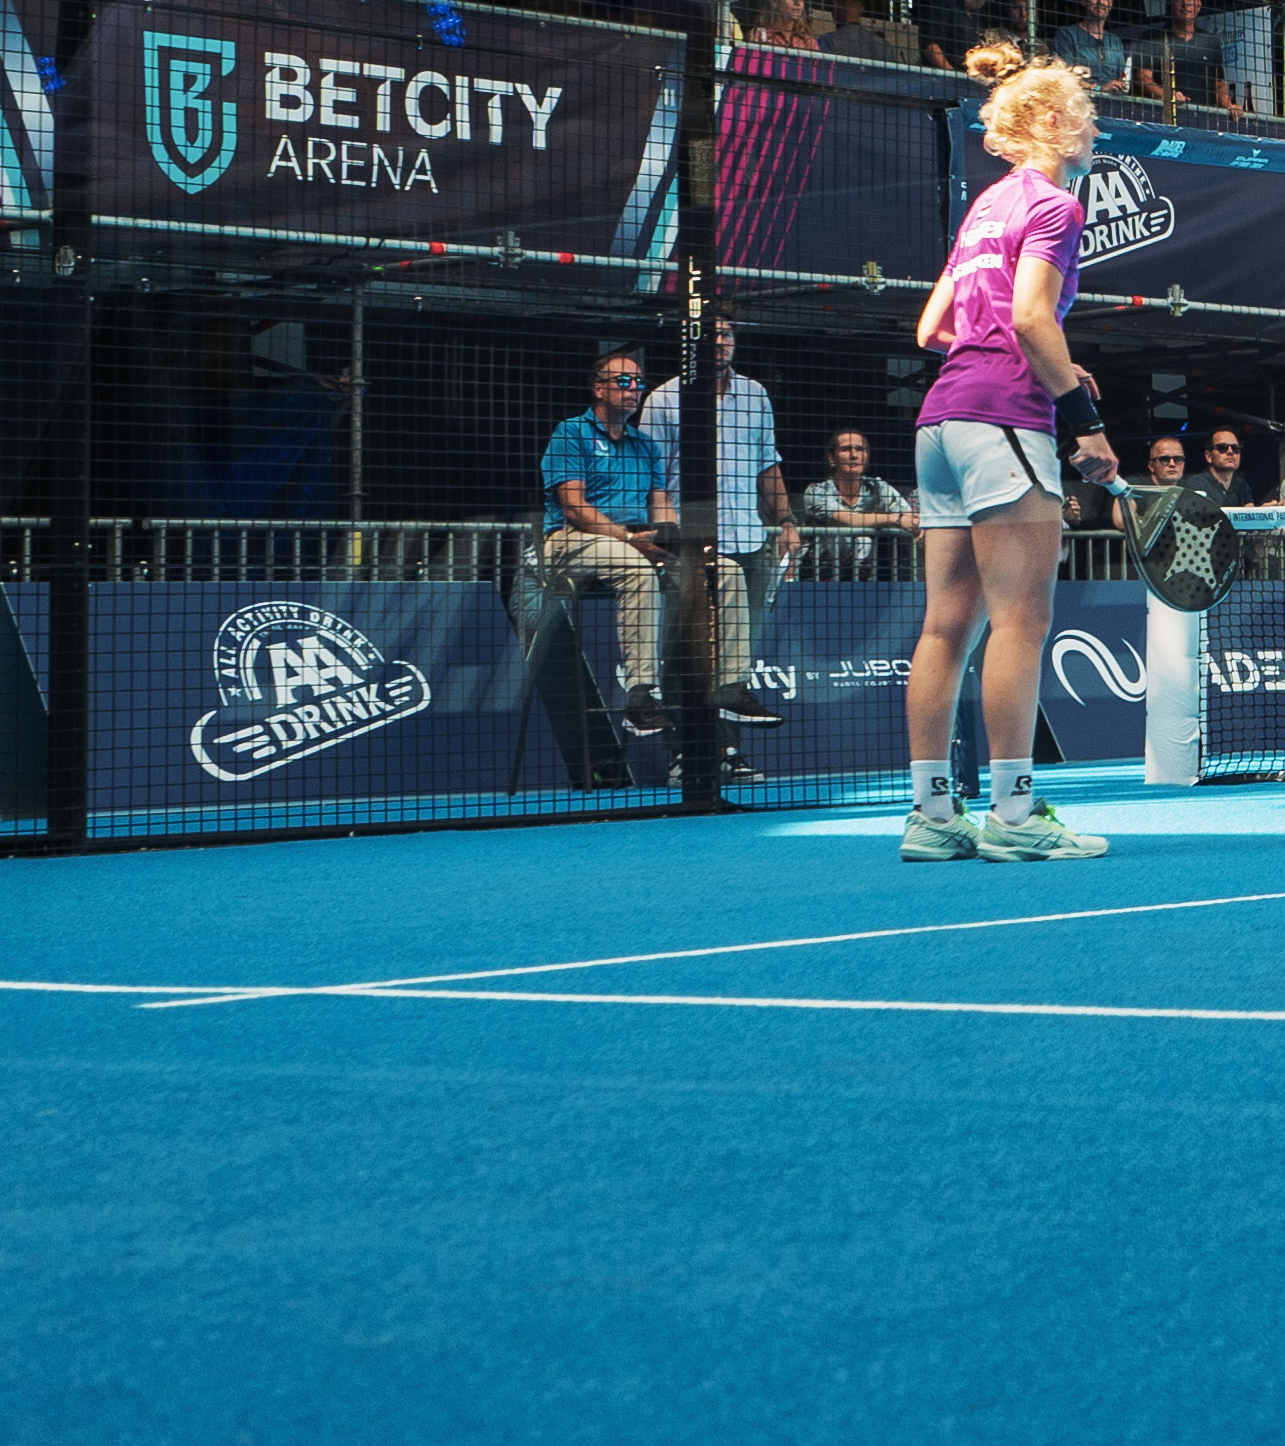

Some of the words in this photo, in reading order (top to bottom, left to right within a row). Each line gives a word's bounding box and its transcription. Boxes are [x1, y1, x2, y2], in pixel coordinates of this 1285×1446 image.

[264, 52, 563, 150] BETCITY
[267, 135, 439, 194] ARENA
[1086, 171, 1140, 225] AA
[265, 636, 365, 709] AA
[265, 682, 395, 750] DRINK
